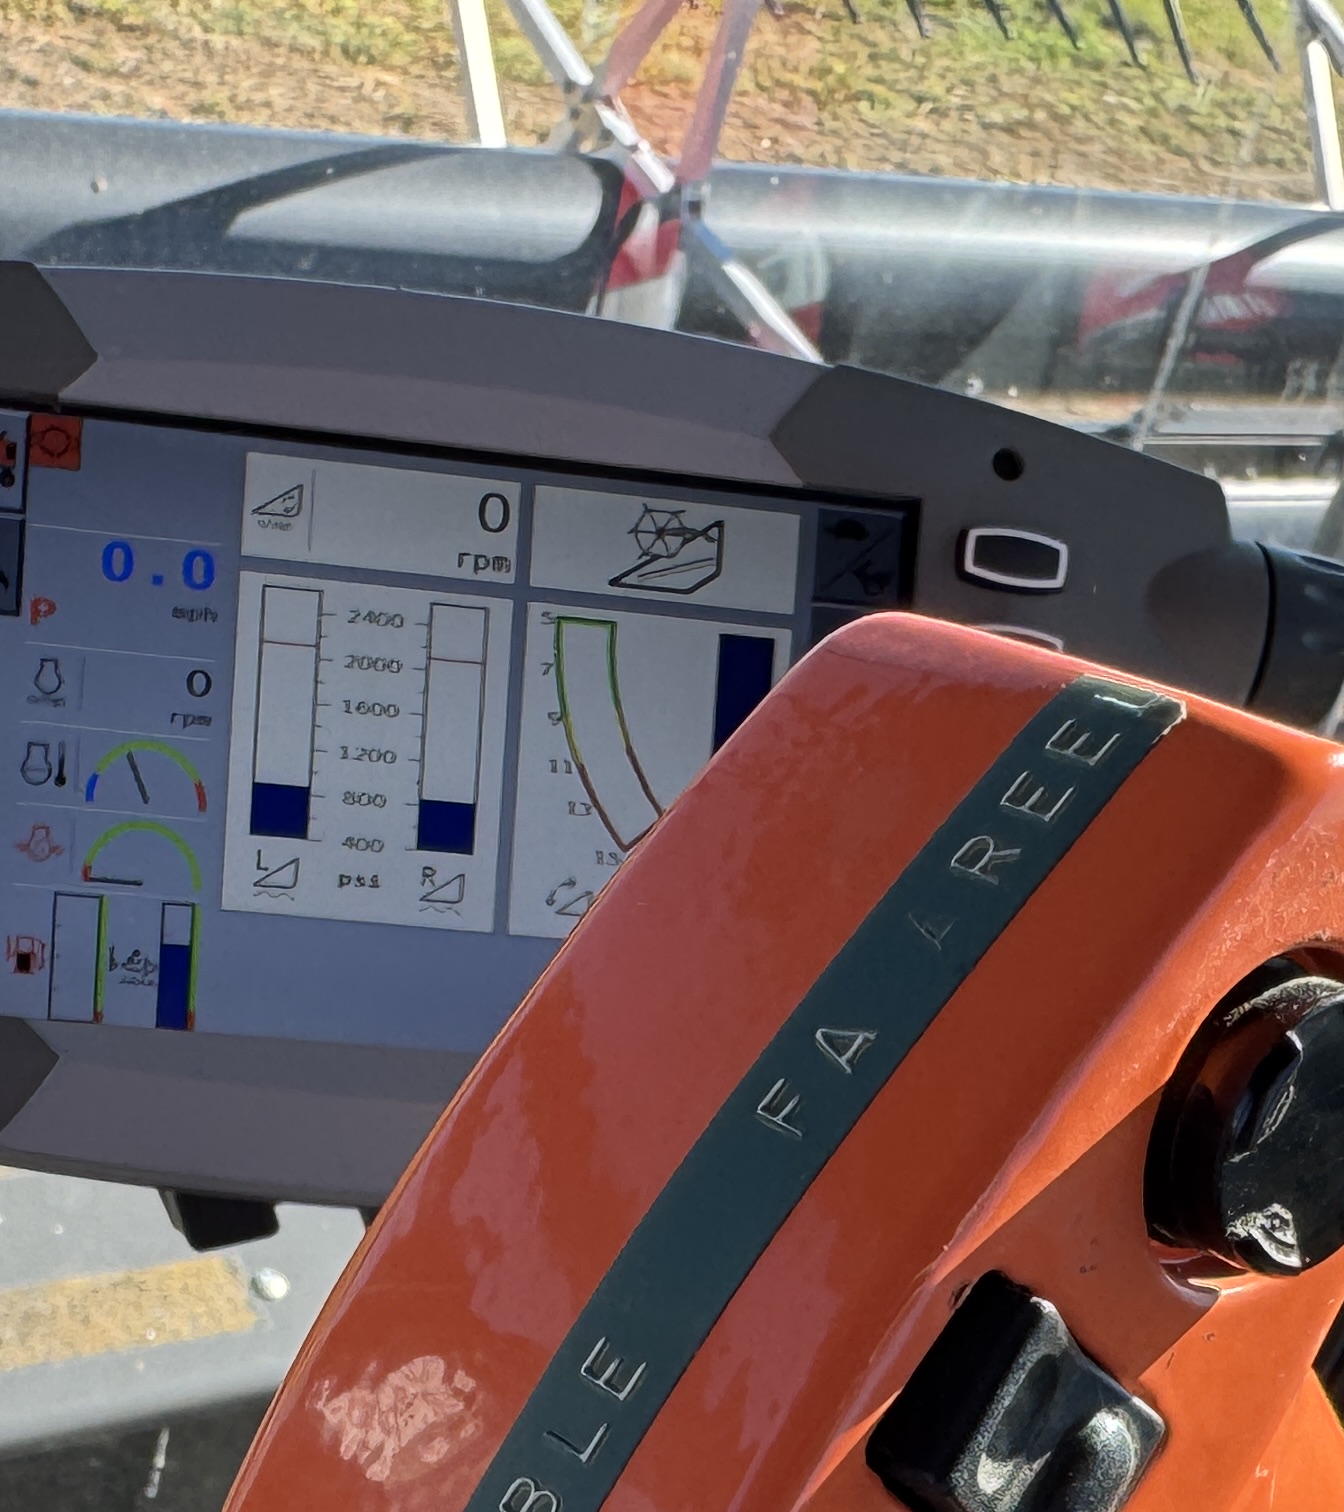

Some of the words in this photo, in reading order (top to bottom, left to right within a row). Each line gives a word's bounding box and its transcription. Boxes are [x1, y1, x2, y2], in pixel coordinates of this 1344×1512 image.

[478, 491, 511, 534] 0
[101, 540, 216, 591] 0.0
[457, 551, 512, 576] rpm
[30, 595, 57, 627] P
[346, 609, 405, 629] 2400
[343, 654, 404, 674] 2000
[186, 668, 212, 698] 0
[342, 699, 401, 718] 1600
[339, 746, 398, 765] 1200
[341, 790, 388, 808] 800
[340, 836, 385, 853] 400
[755, 1027, 878, 1140] FA
[949, 692, 1164, 886] REEL
